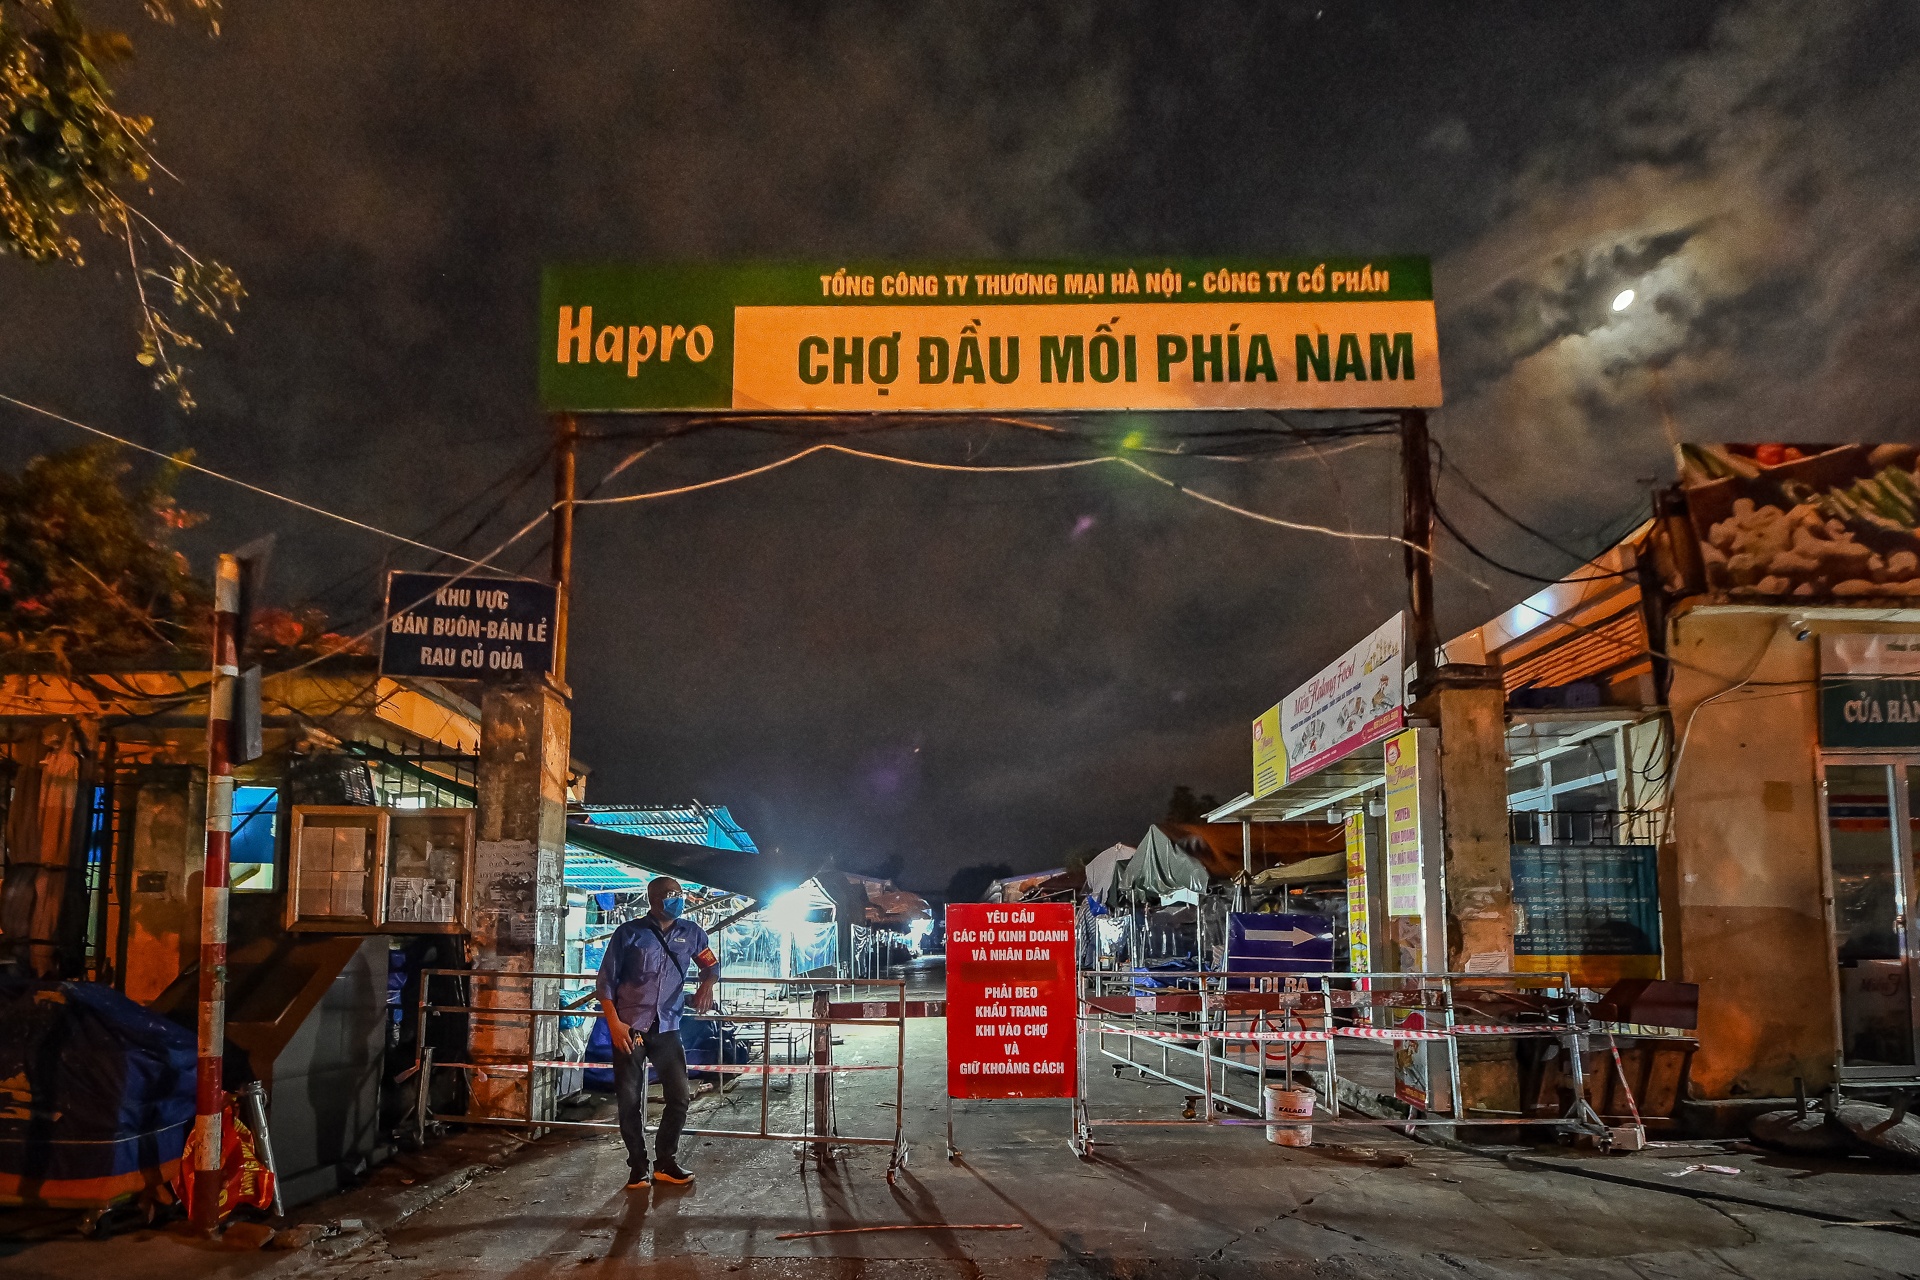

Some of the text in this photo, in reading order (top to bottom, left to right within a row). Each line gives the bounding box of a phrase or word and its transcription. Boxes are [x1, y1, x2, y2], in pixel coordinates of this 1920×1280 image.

[821, 267, 874, 297] TỔNG
[881, 270, 938, 297] CÔNG
[944, 275, 967, 296] TY
[974, 272, 1057, 296] THƯƠNG
[1064, 273, 1104, 299] MẠI
[1111, 267, 1140, 294] HÀ
[1146, 267, 1182, 298] NỘI
[1203, 267, 1260, 294] CÔNG
[1266, 272, 1291, 293] TY
[1296, 264, 1326, 294] CỔ
[556, 305, 715, 379] Hapro
[798, 316, 1416, 397] CHỢ ĐẦU MỐI PHÍA NAM
[435, 588, 509, 613] KHU VỰC
[391, 612, 429, 635] BÁN
[527, 617, 547, 642] LẺ
[420, 646, 456, 667] RAU
[460, 643, 484, 668] CỦ
[1843, 691, 1884, 723] CỬA
[986, 908, 1035, 924] YÊU CẦU
[953, 929, 1069, 945] CÁC HỘ KINH DOANH
[972, 947, 1050, 961] VÀ NHÂN DÂN
[984, 983, 1038, 999] PHẢI ĐEO
[1284, 977, 1309, 993] RA
[975, 1001, 1047, 1018] KHẨU TRANG
[975, 1022, 1048, 1038] KHI VÀO CHỢ
[1004, 1041, 1020, 1055] VÀ
[959, 1059, 1064, 1075] GIỮ KHOẢNG CÁCH
